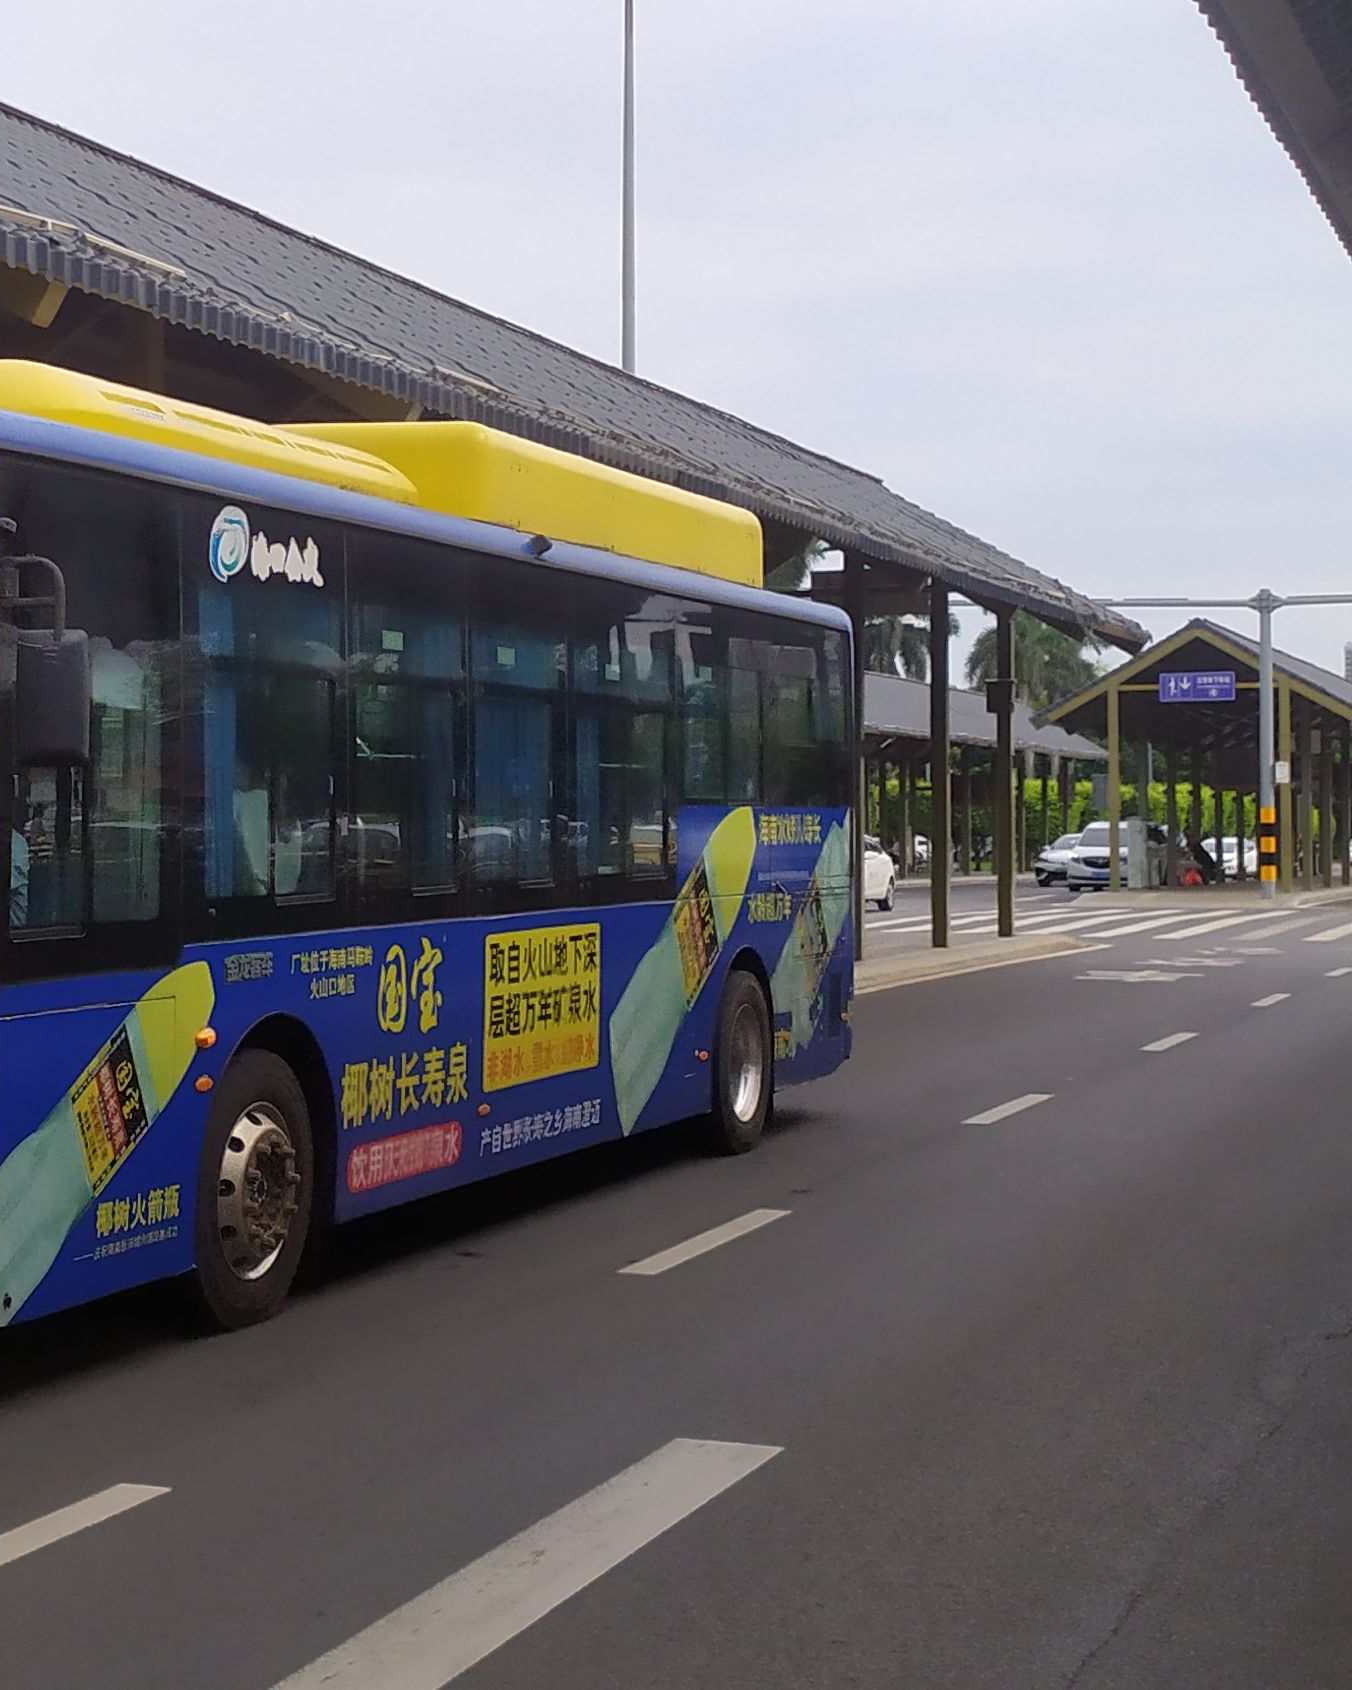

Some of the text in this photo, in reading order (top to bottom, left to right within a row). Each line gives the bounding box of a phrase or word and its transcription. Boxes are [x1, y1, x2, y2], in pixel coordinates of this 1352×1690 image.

[309, 974, 356, 1000] 火山口地区
[377, 935, 444, 1035] 国宝
[489, 932, 598, 986] 取自火山地下深
[488, 980, 597, 1039] 层超万年矿泉水
[340, 1041, 469, 1130] 椰树长寿泉
[95, 1184, 181, 1239] 椰树火箭瓶
